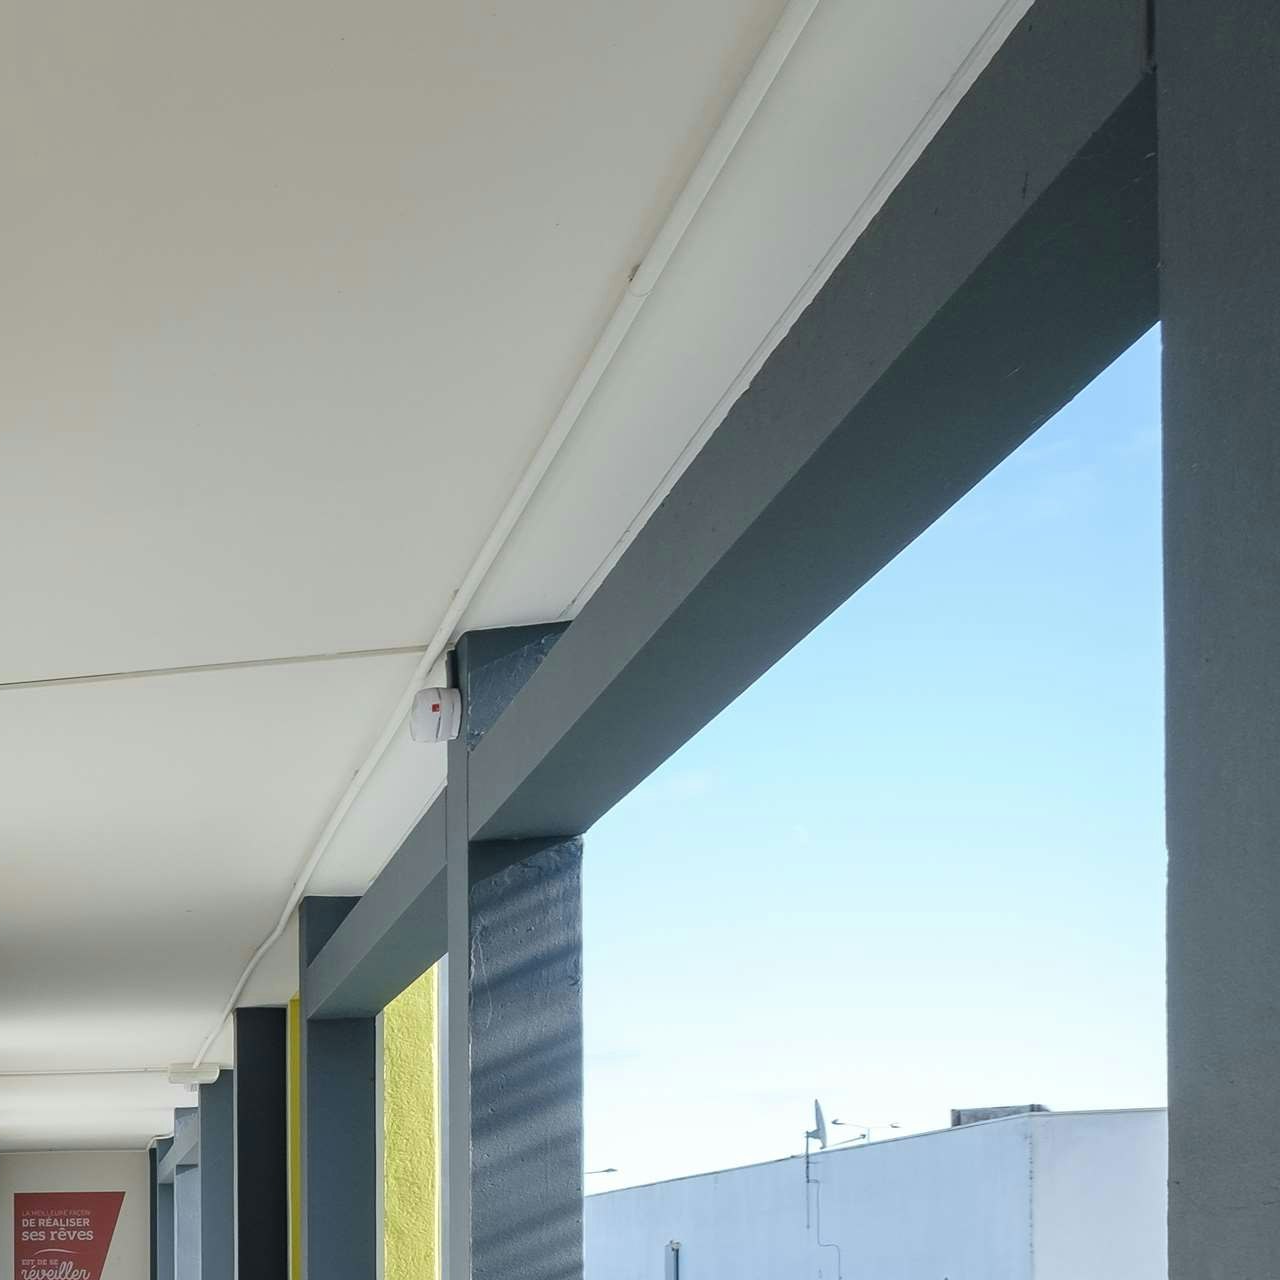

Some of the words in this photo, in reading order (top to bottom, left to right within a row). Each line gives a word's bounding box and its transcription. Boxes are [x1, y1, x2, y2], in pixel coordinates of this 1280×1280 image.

[22, 1218, 36, 1228] DE
[38, 1216, 90, 1228] RÉALISER
[22, 1231, 46, 1241] ses
[49, 1227, 94, 1241] rêves
[21, 1261, 91, 1280] réveiller
